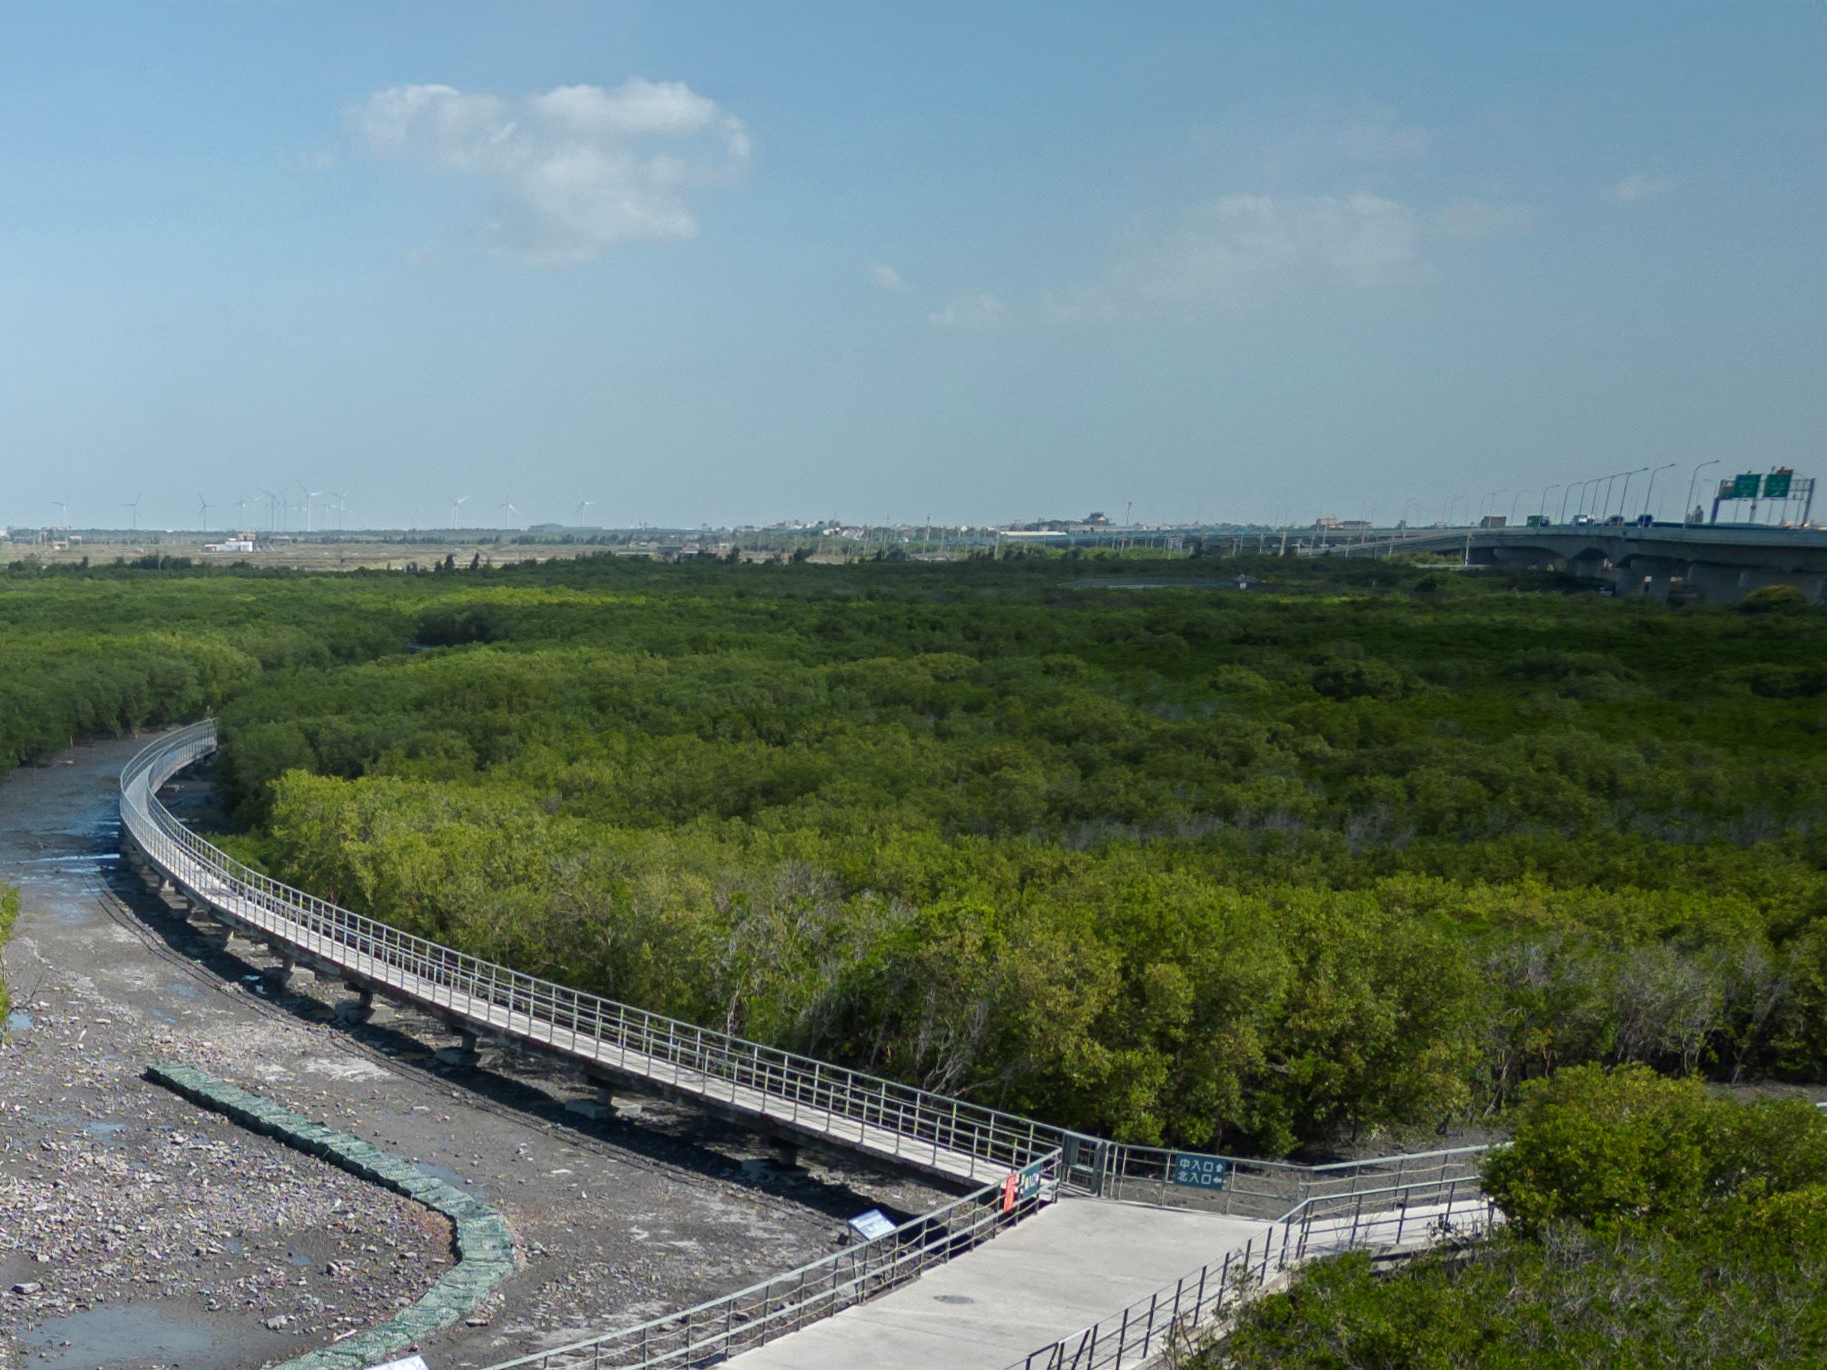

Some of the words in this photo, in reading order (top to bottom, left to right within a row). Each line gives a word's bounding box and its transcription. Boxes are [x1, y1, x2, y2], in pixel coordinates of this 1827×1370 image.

[1179, 1157, 1213, 1173] 中入口
[1177, 1170, 1212, 1185] 北入口
